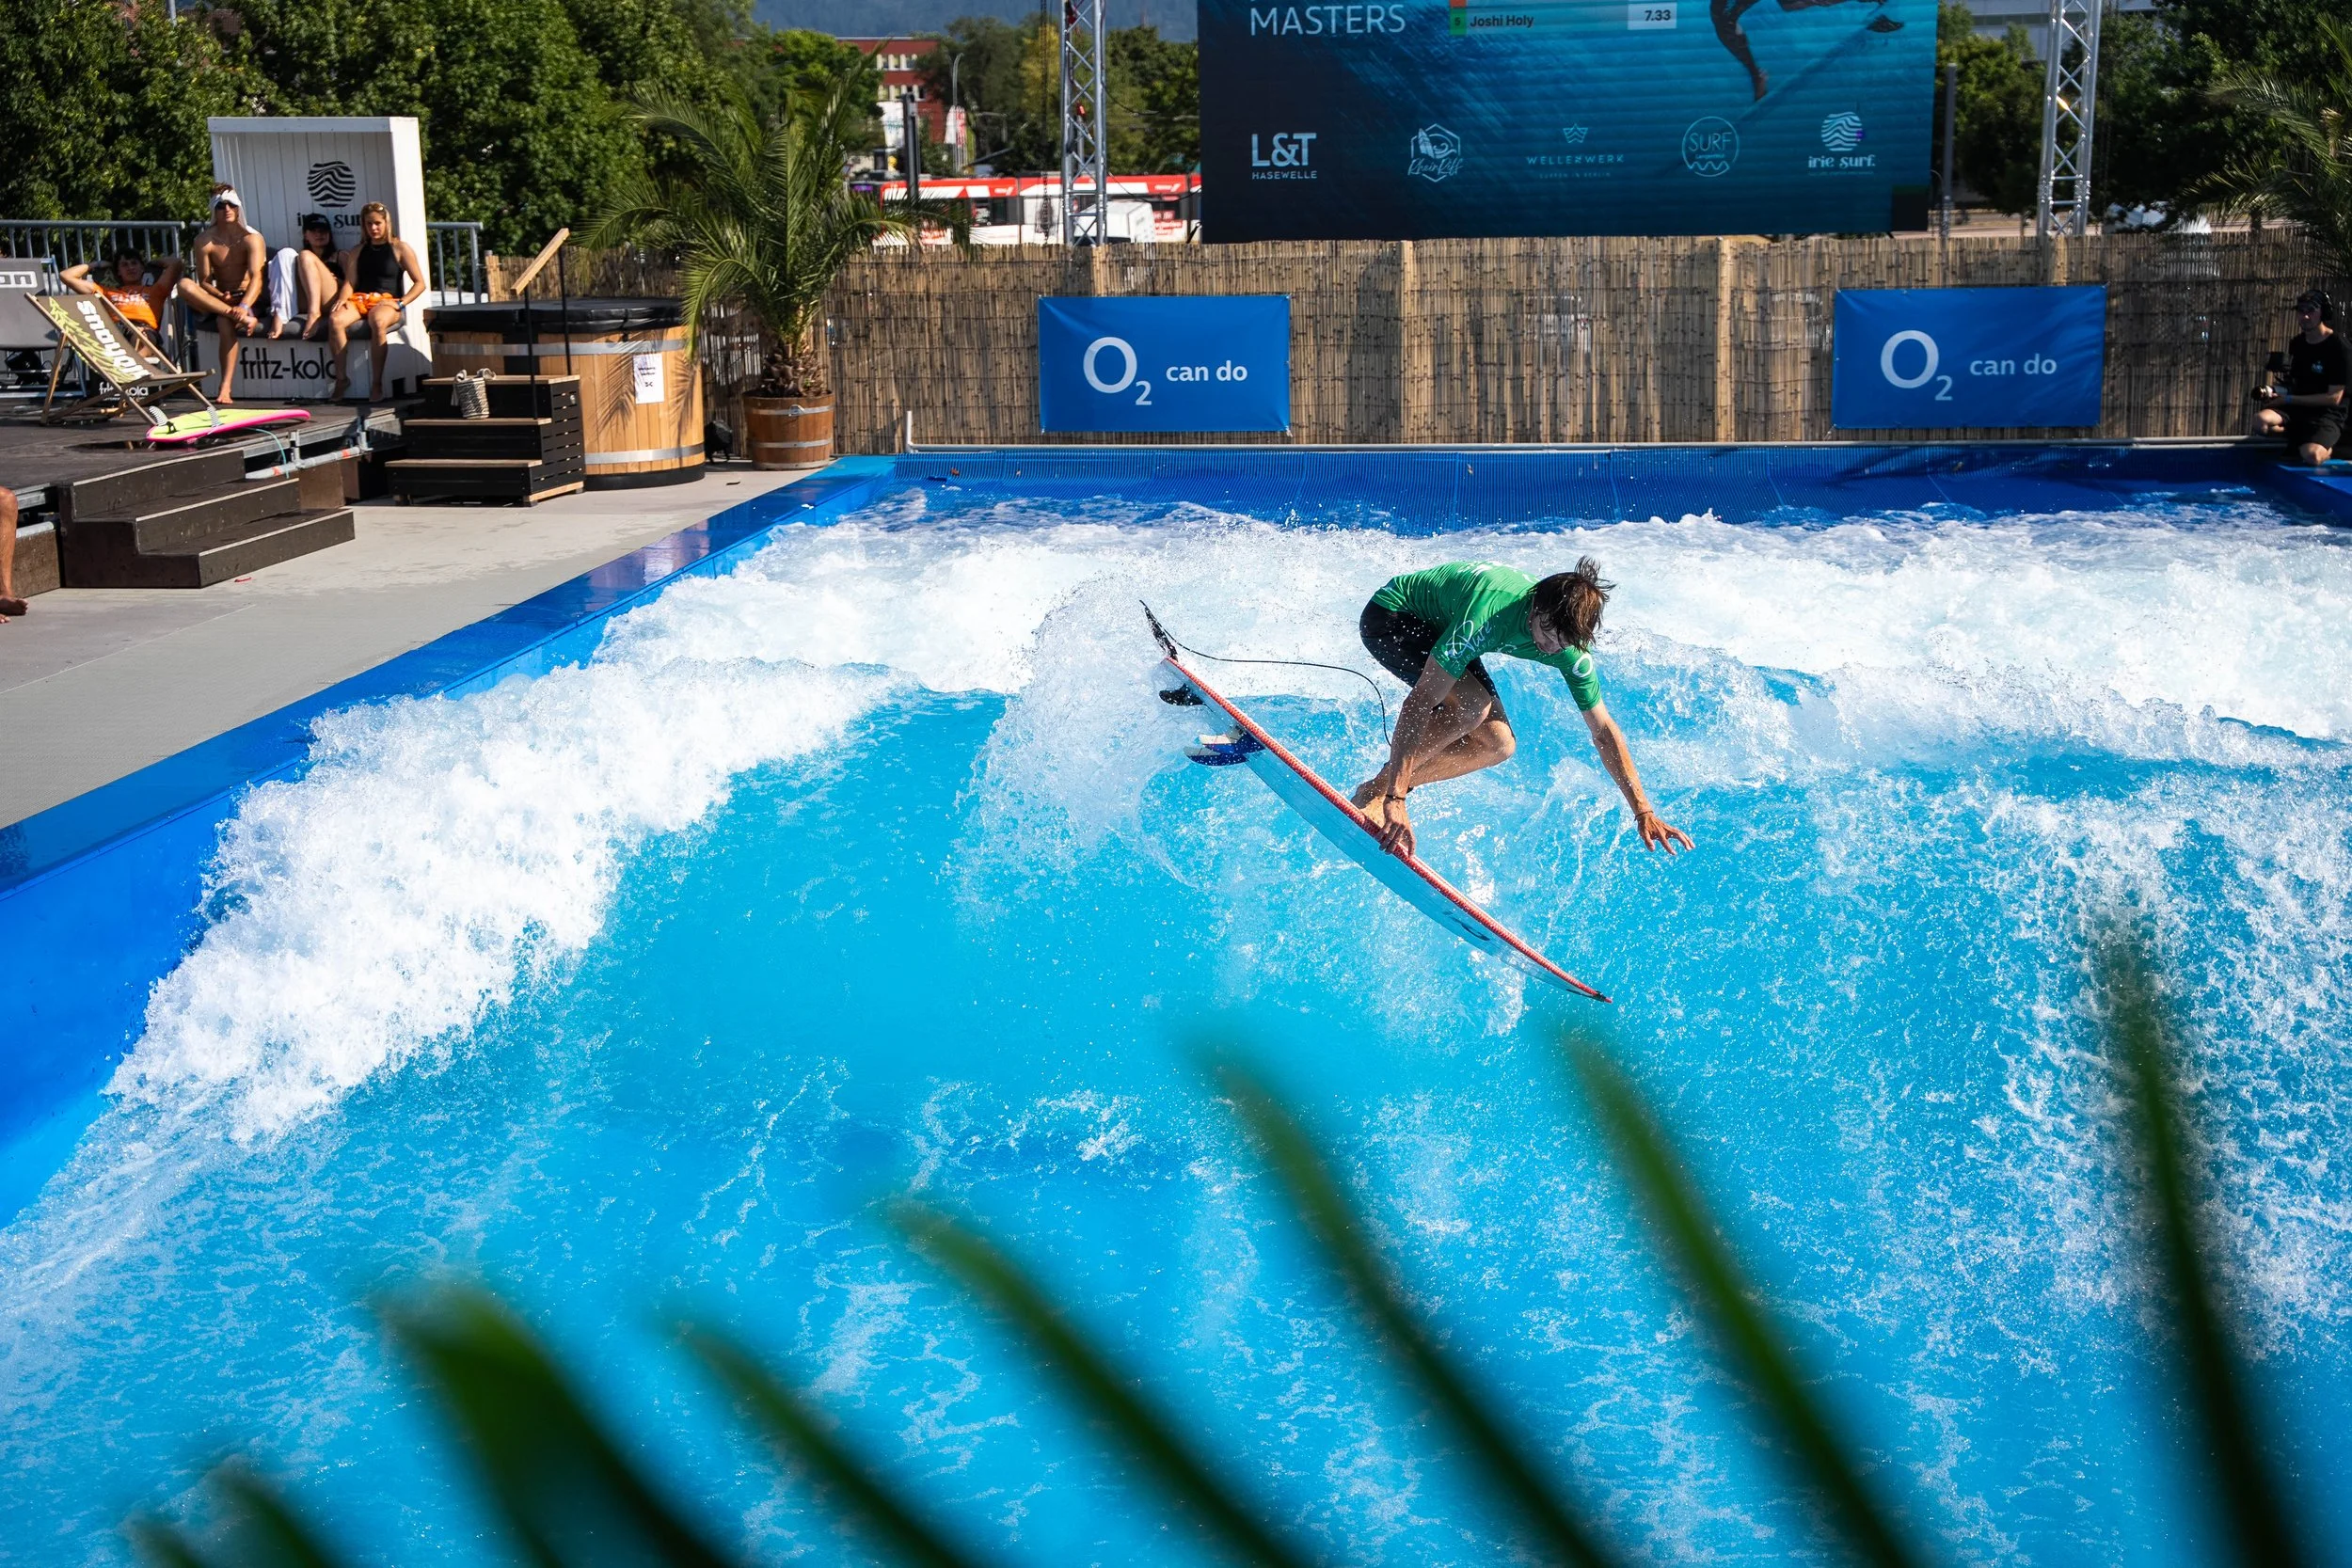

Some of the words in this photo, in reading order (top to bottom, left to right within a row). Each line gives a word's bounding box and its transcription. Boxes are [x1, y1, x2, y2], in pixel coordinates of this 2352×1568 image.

[1250, 4, 1406, 36] MASTERS
[1470, 14, 1503, 27] Joshi
[1505, 14, 1534, 28] Holy
[1644, 9, 1672, 23] 7.33
[1251, 132, 1318, 167] L&T
[1688, 132, 1733, 151] SURF
[1525, 153, 1625, 166] WELLENWERK
[1808, 154, 1836, 168] irie
[1251, 170, 1318, 181] HASEWELLE
[333, 214, 362, 229] sur
[1166, 365, 1209, 382] can
[1216, 359, 1248, 382] do
[1969, 358, 2015, 375] can
[2023, 353, 2058, 374] do
